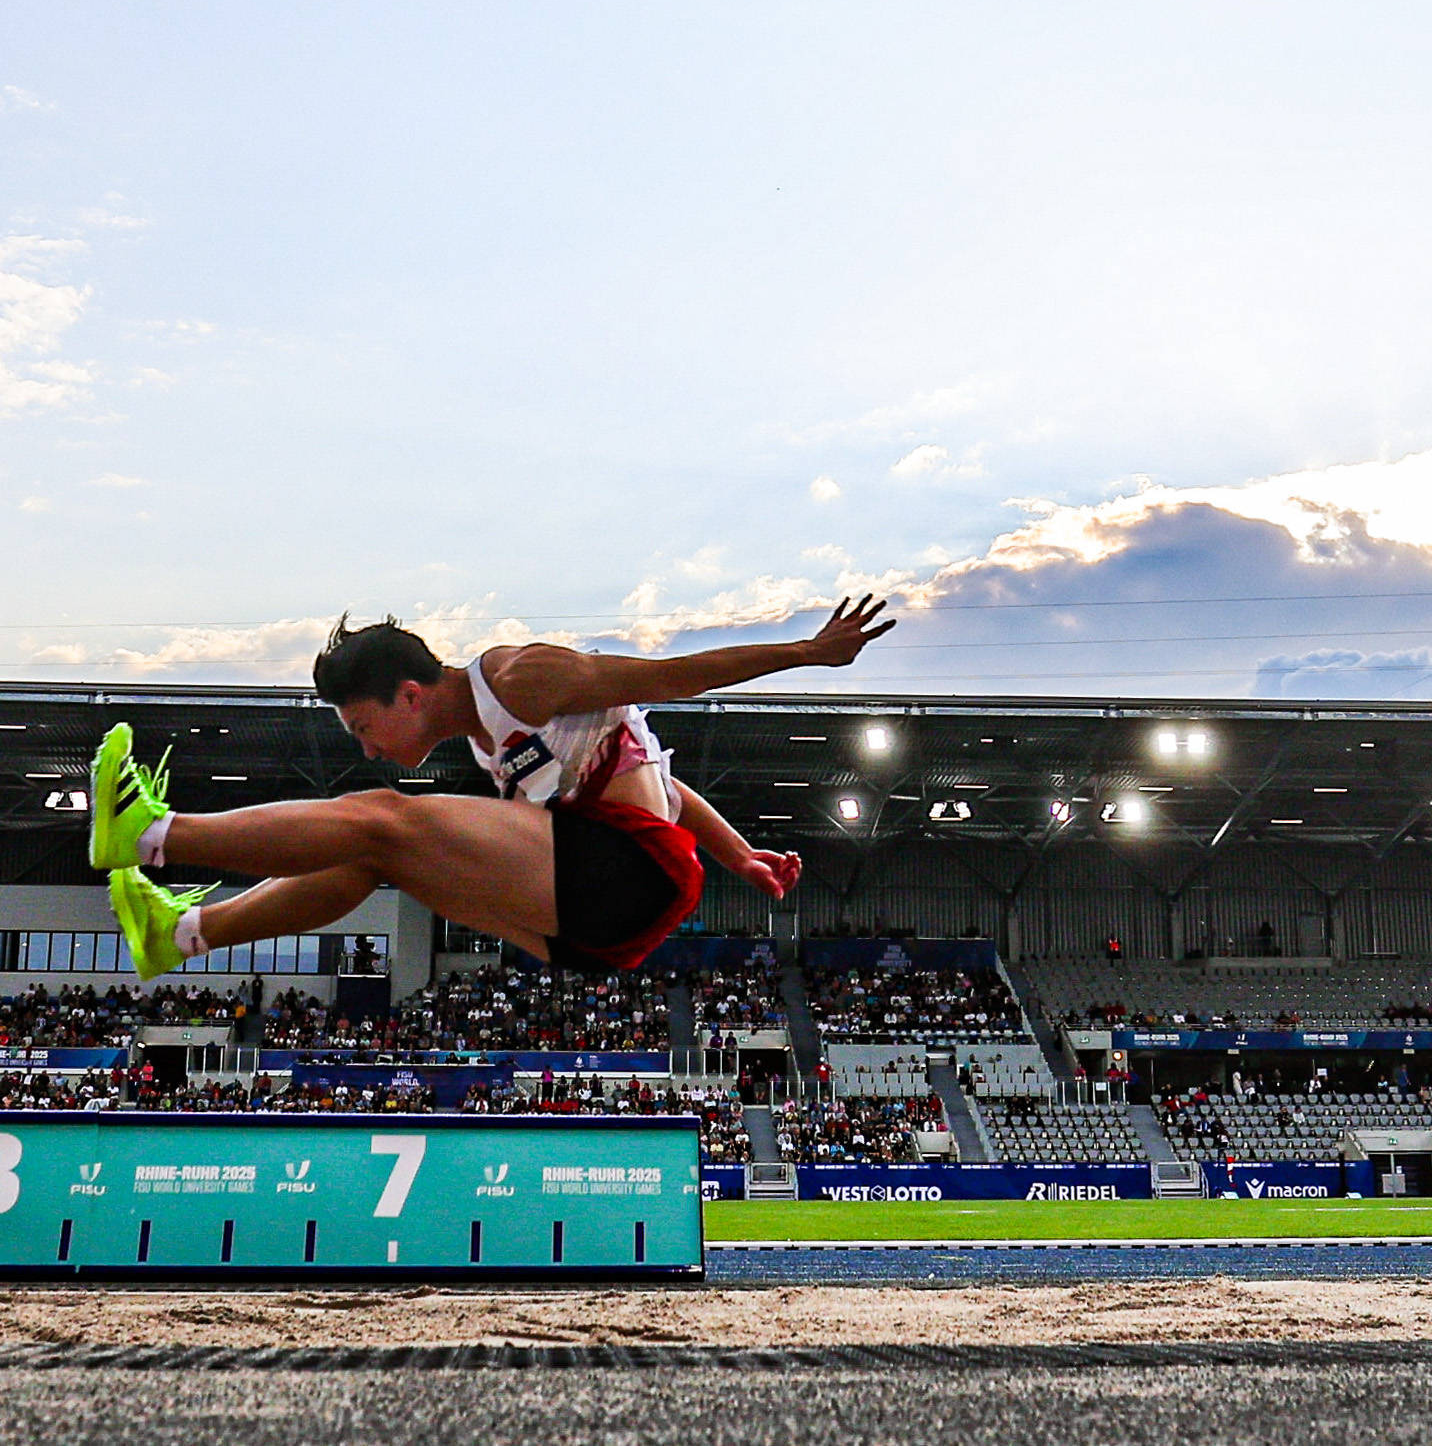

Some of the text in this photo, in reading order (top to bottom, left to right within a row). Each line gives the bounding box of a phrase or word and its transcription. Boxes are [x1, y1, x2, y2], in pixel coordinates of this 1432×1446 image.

[135, 1166, 257, 1180] RHINE-RUHR 2025
[371, 1134, 427, 1218] 7
[543, 1167, 662, 1182] RHINE-RUHR 2025
[70, 1184, 107, 1196] FISU
[276, 1182, 316, 1193] FISU
[476, 1186, 515, 1196] FISU
[683, 1185, 698, 1195] FI
[822, 1186, 942, 1201] WEST LOTTO
[1058, 1185, 1121, 1201] RIEDEL
[1268, 1185, 1328, 1197] macron
